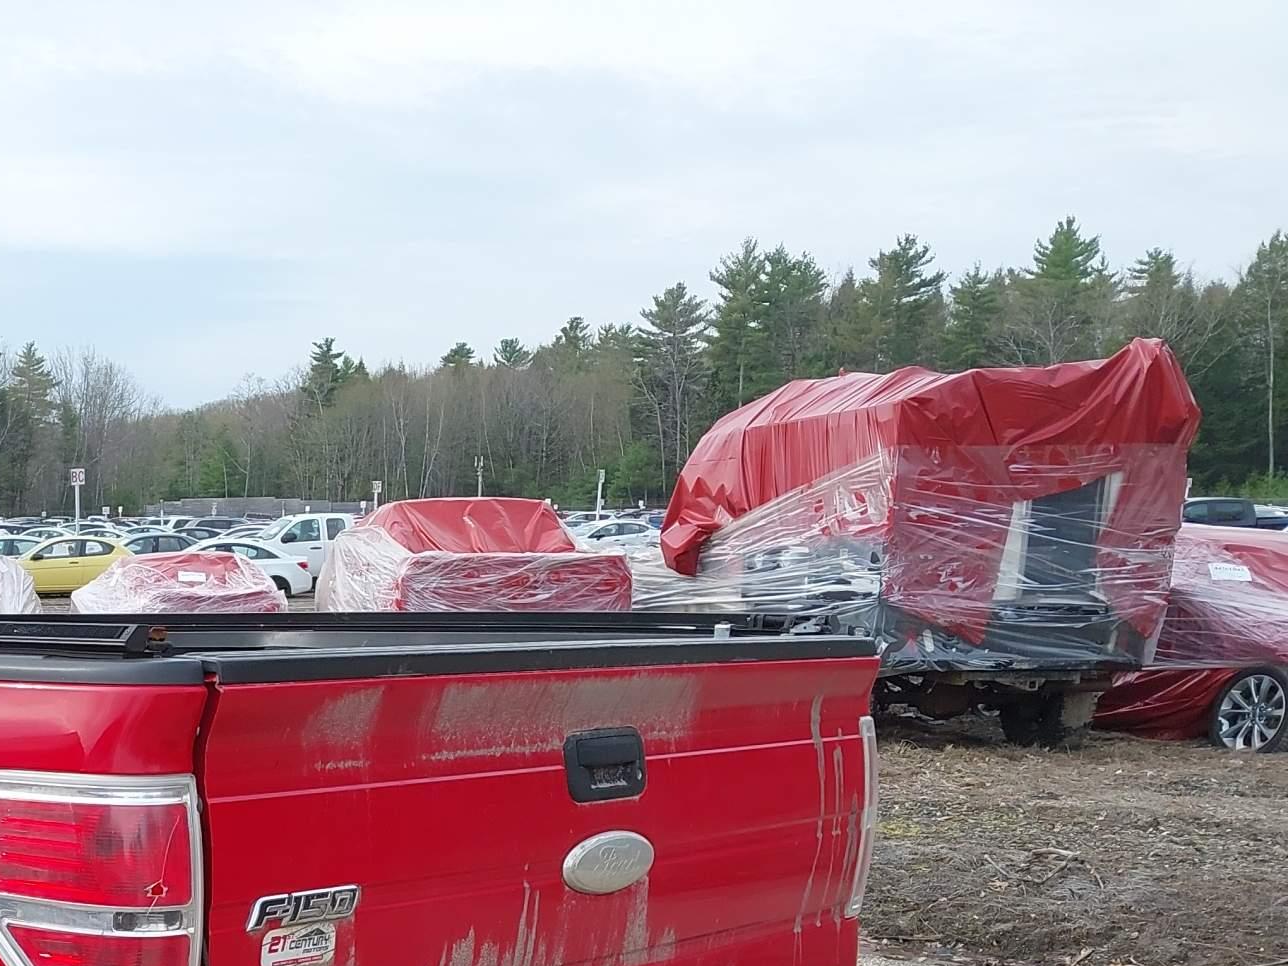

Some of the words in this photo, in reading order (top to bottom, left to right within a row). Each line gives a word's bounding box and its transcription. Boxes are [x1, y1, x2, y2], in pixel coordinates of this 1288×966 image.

[71, 471, 85, 483] BC
[592, 843, 641, 876] Ford
[246, 884, 361, 932] F-150
[289, 934, 331, 951] CENTURY
